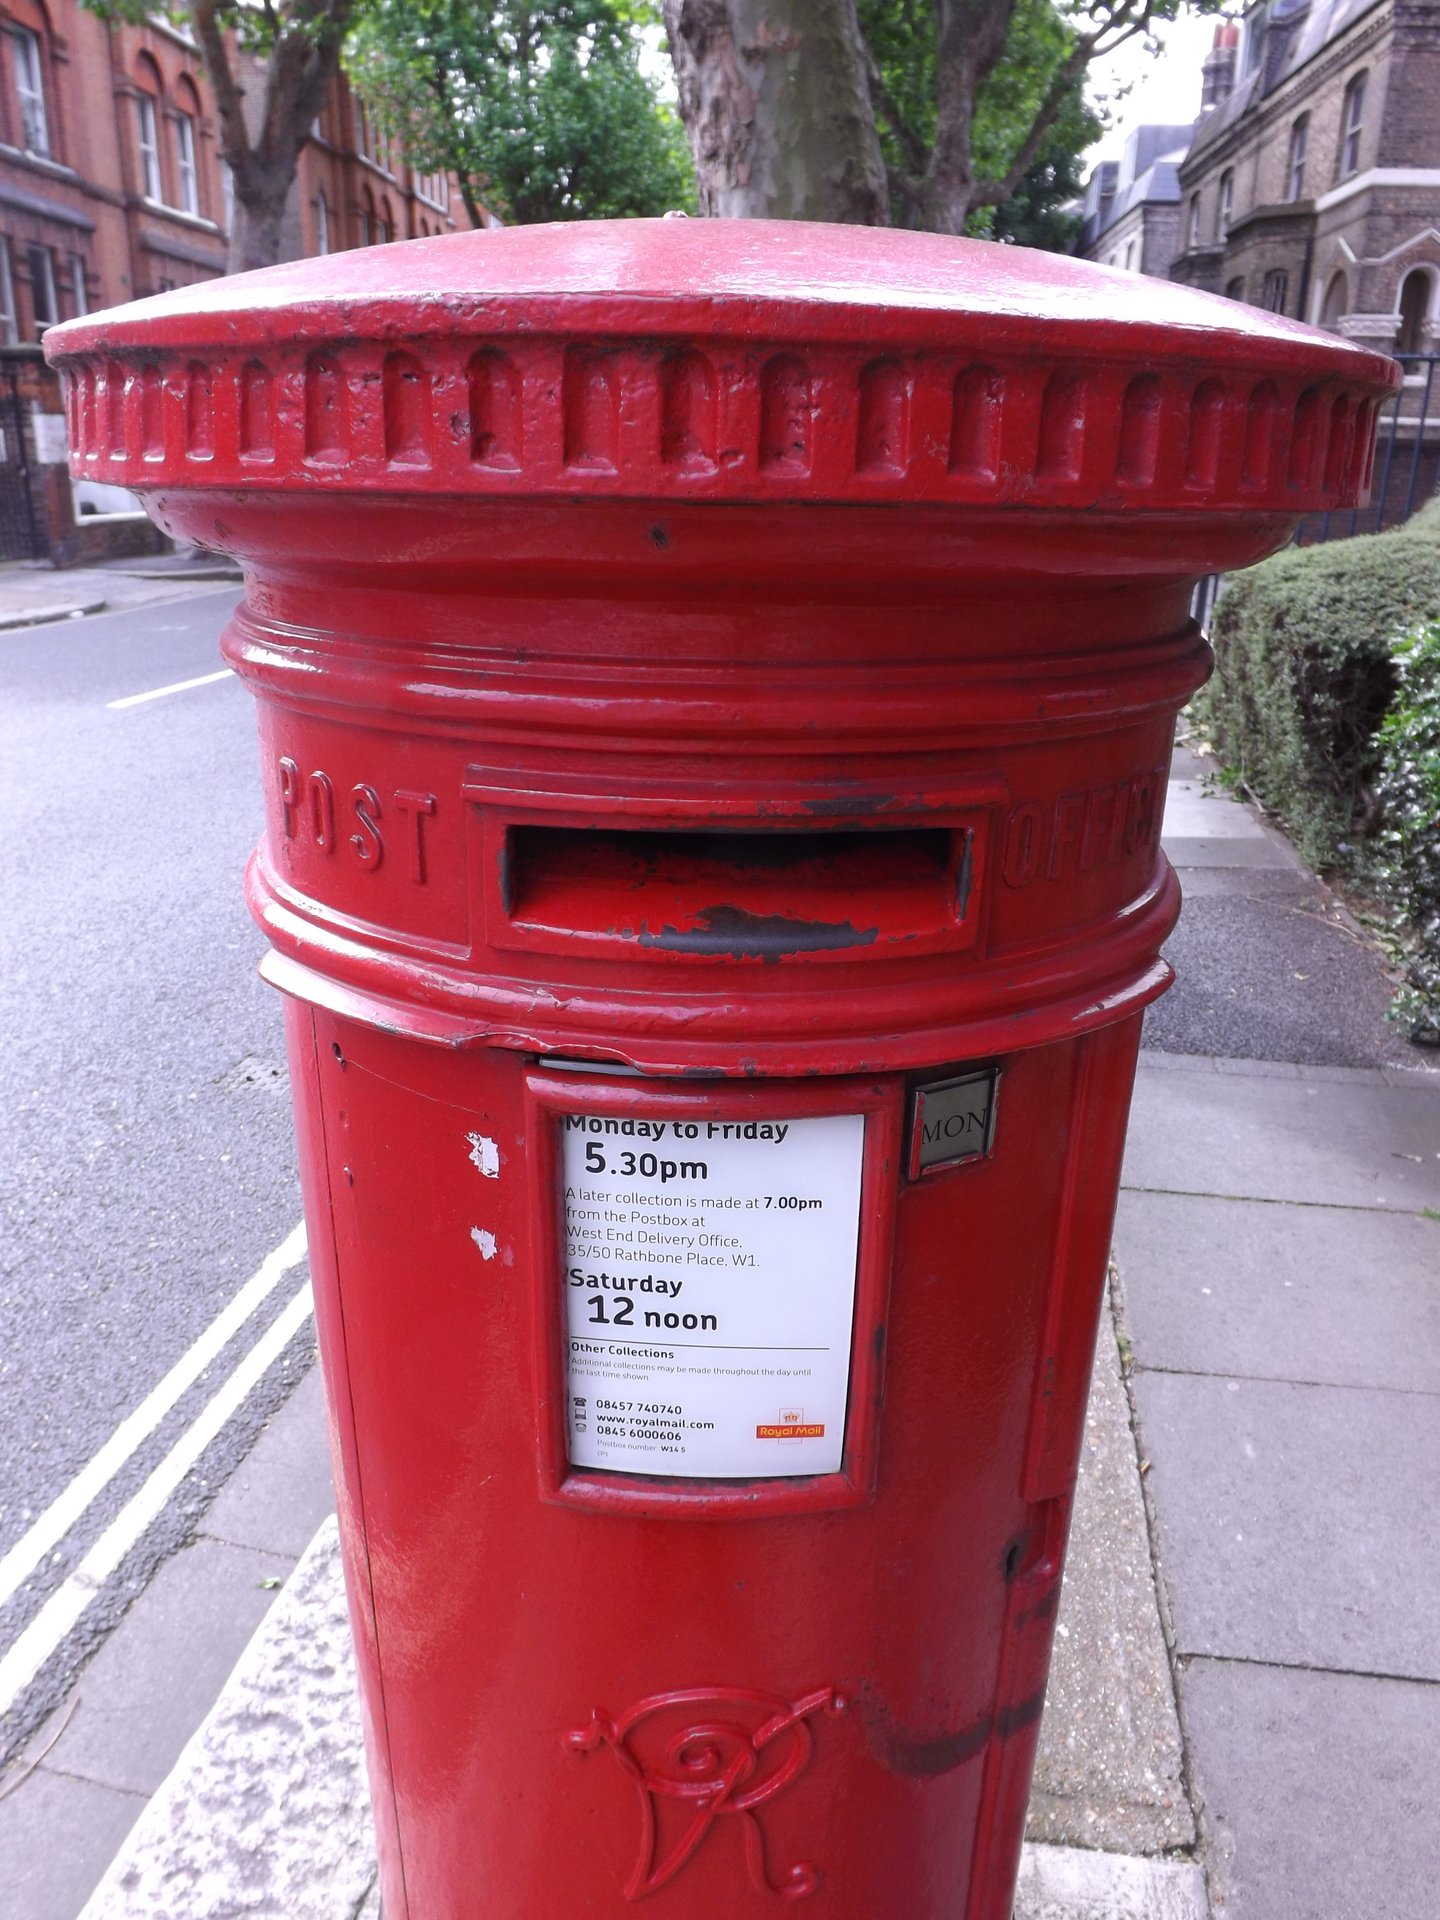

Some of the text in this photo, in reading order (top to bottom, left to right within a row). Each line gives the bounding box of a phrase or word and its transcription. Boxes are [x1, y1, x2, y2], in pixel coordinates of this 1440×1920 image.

[278, 757, 437, 886] POST
[566, 1115, 789, 1143] Monday to Friday
[921, 1108, 988, 1145] MON
[585, 1142, 708, 1183] 5.30pm
[566, 1187, 823, 1211] A later collection is made at 7.00pm
[566, 1206, 705, 1227] from the Postbox at
[566, 1226, 743, 1248] West End Delivery Office,
[567, 1244, 760, 1267] 35/50 Rathbone Place, W1.
[569, 1268, 683, 1298] Saturday
[587, 1295, 718, 1330] 12 noon
[571, 1341, 675, 1359] Other Collections
[571, 1357, 812, 1376] Additional collections may be made throughout the day until
[571, 1367, 585, 1376] the
[586, 1370, 602, 1378] last
[602, 1371, 621, 1379] time
[596, 1399, 682, 1415] 08457 740740
[596, 1414, 715, 1430] www.royalmail.com
[760, 1425, 821, 1437] Royal Mail
[597, 1425, 682, 1441] 0845 6000606
[597, 1439, 626, 1449] Postbox
[627, 1443, 657, 1452] number
[661, 1445, 679, 1453] W14
